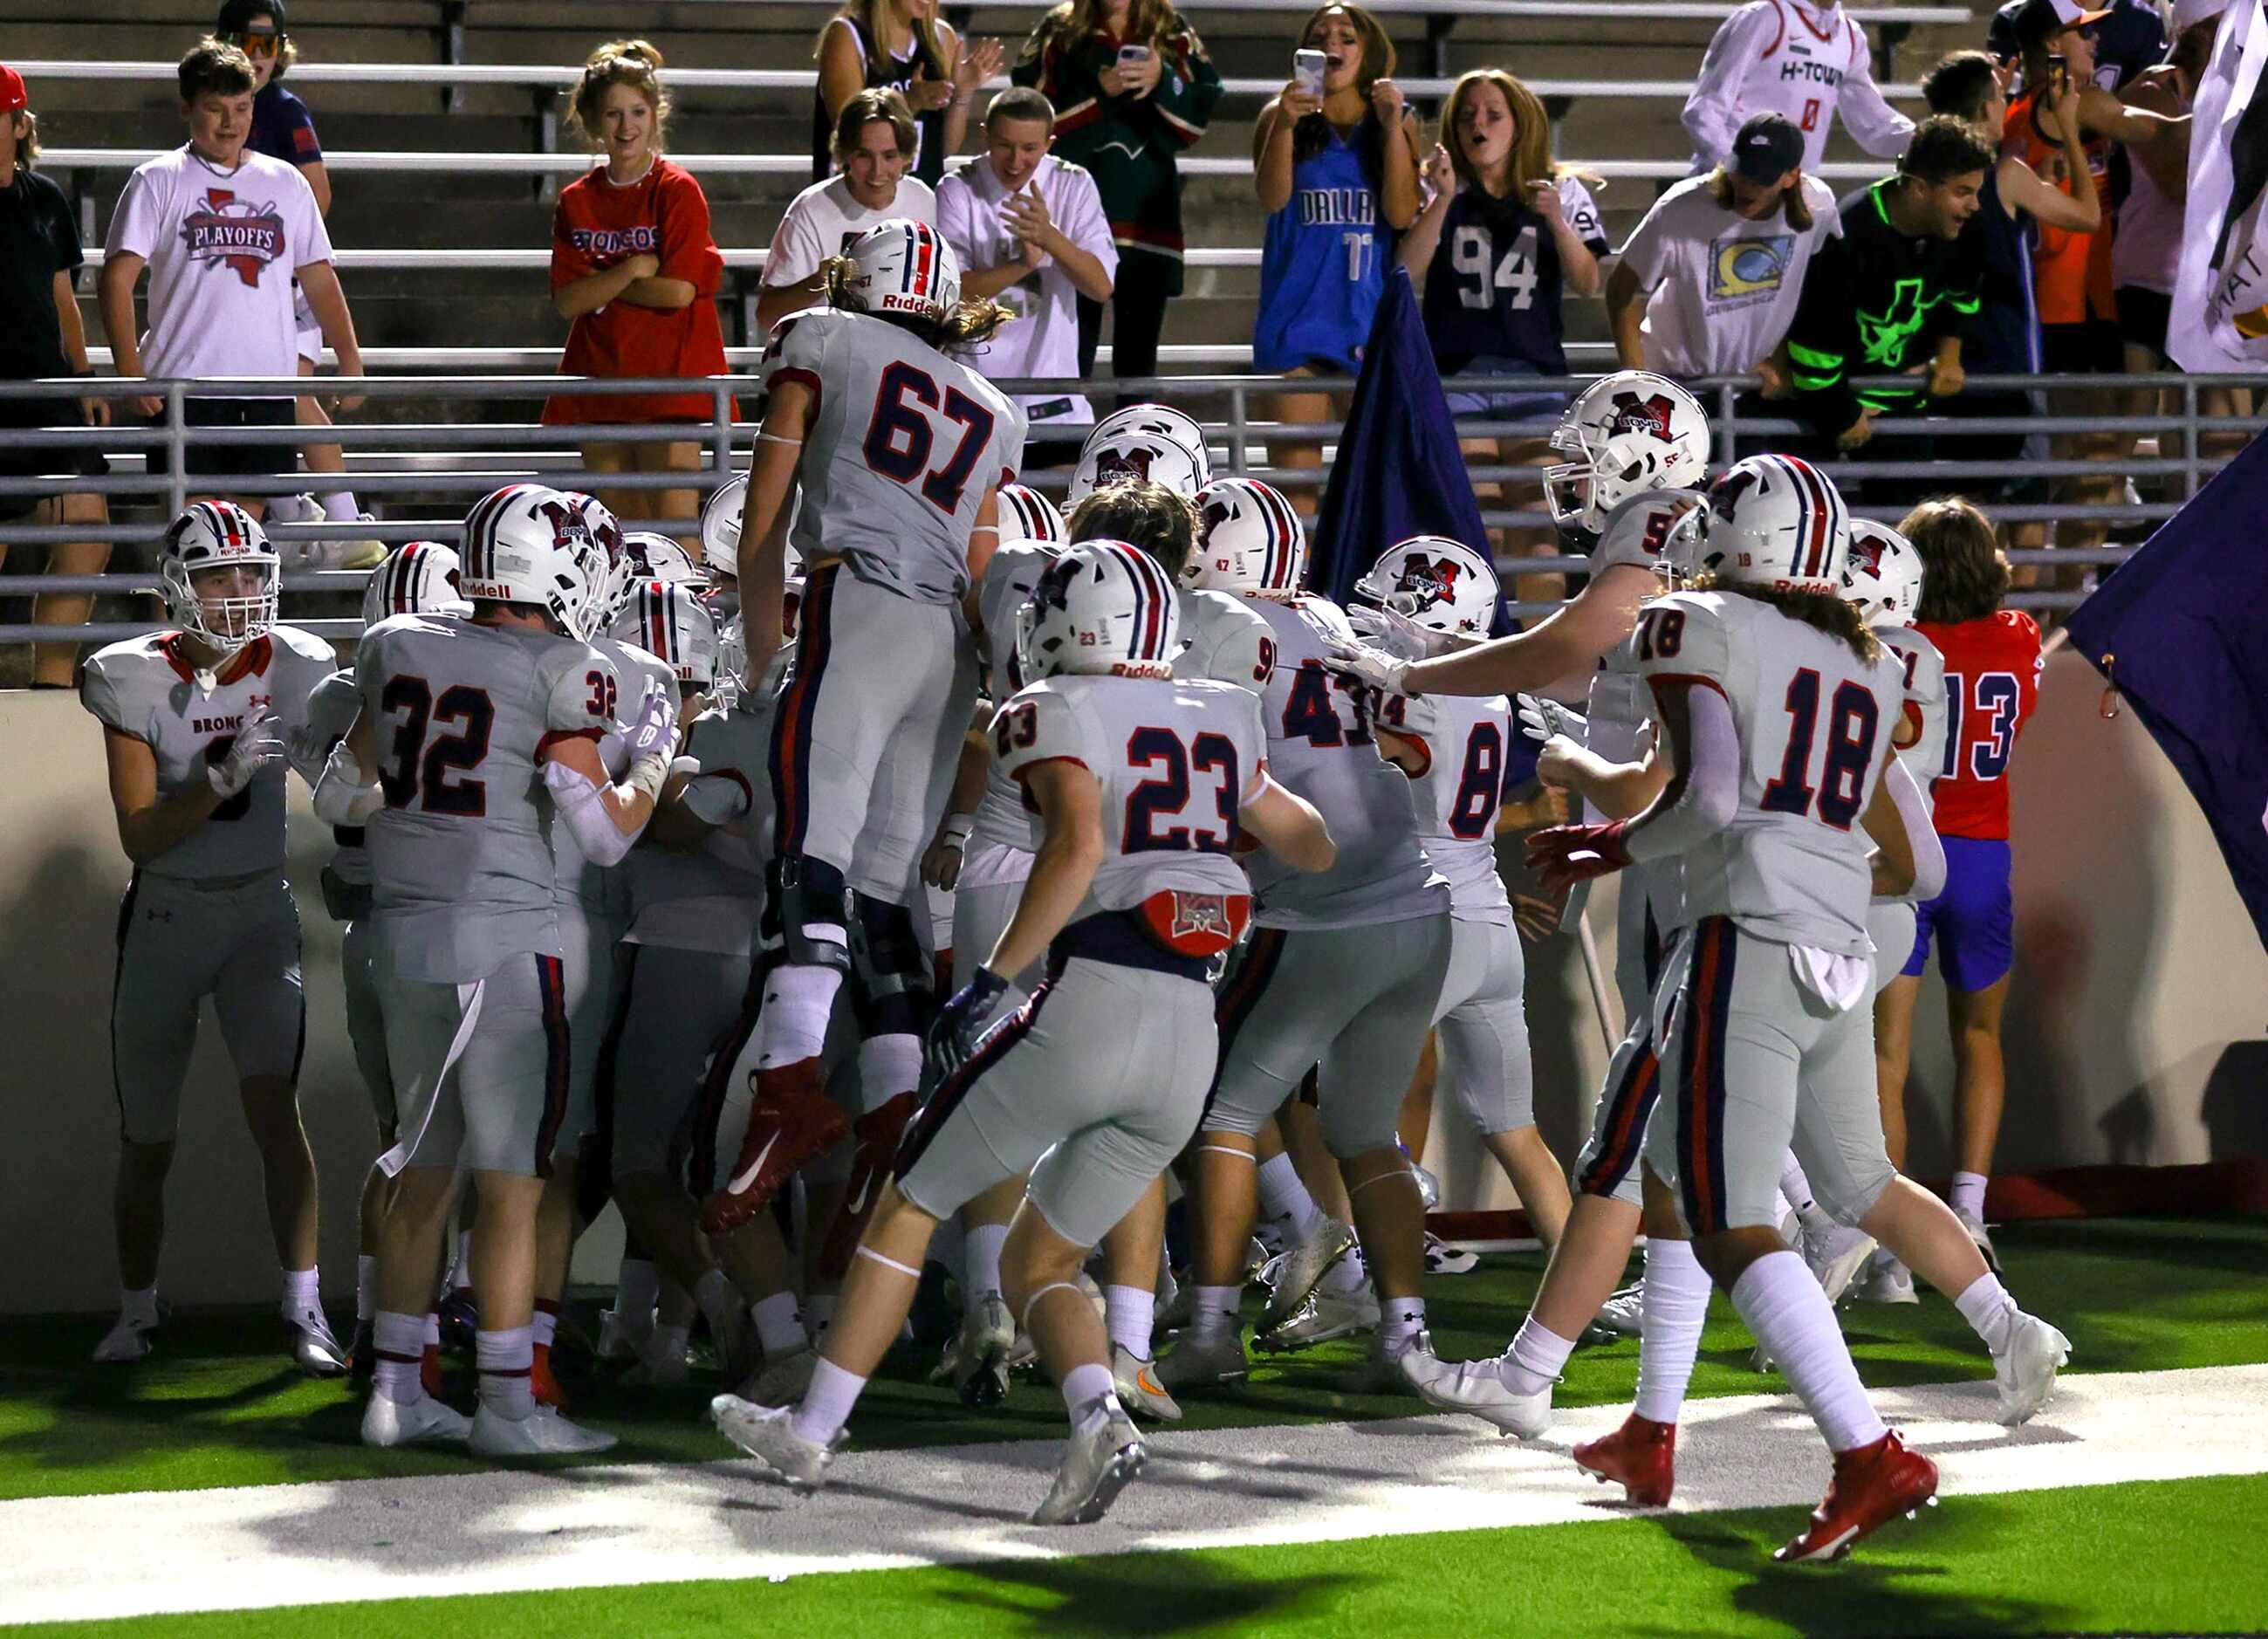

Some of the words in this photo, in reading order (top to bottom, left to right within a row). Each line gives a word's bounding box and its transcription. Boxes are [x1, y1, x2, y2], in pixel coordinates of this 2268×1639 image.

[1298, 188, 1375, 226] DALLA
[194, 226, 275, 249] PLAYOFFS
[1452, 225, 1538, 310] 94
[882, 294, 936, 316] Ridde
[862, 360, 995, 516] 67
[1215, 559, 1230, 573] 47
[1773, 579, 1839, 595] Riddell
[1640, 609, 1686, 662] 18
[586, 669, 618, 723] 32
[1112, 662, 1174, 682] Riddell
[192, 715, 245, 734] BRONC
[376, 674, 497, 818] 32
[1759, 667, 1879, 832] 18
[1941, 672, 2021, 781] 13
[1120, 726, 1240, 856] 23
[1448, 721, 1504, 839] 8
